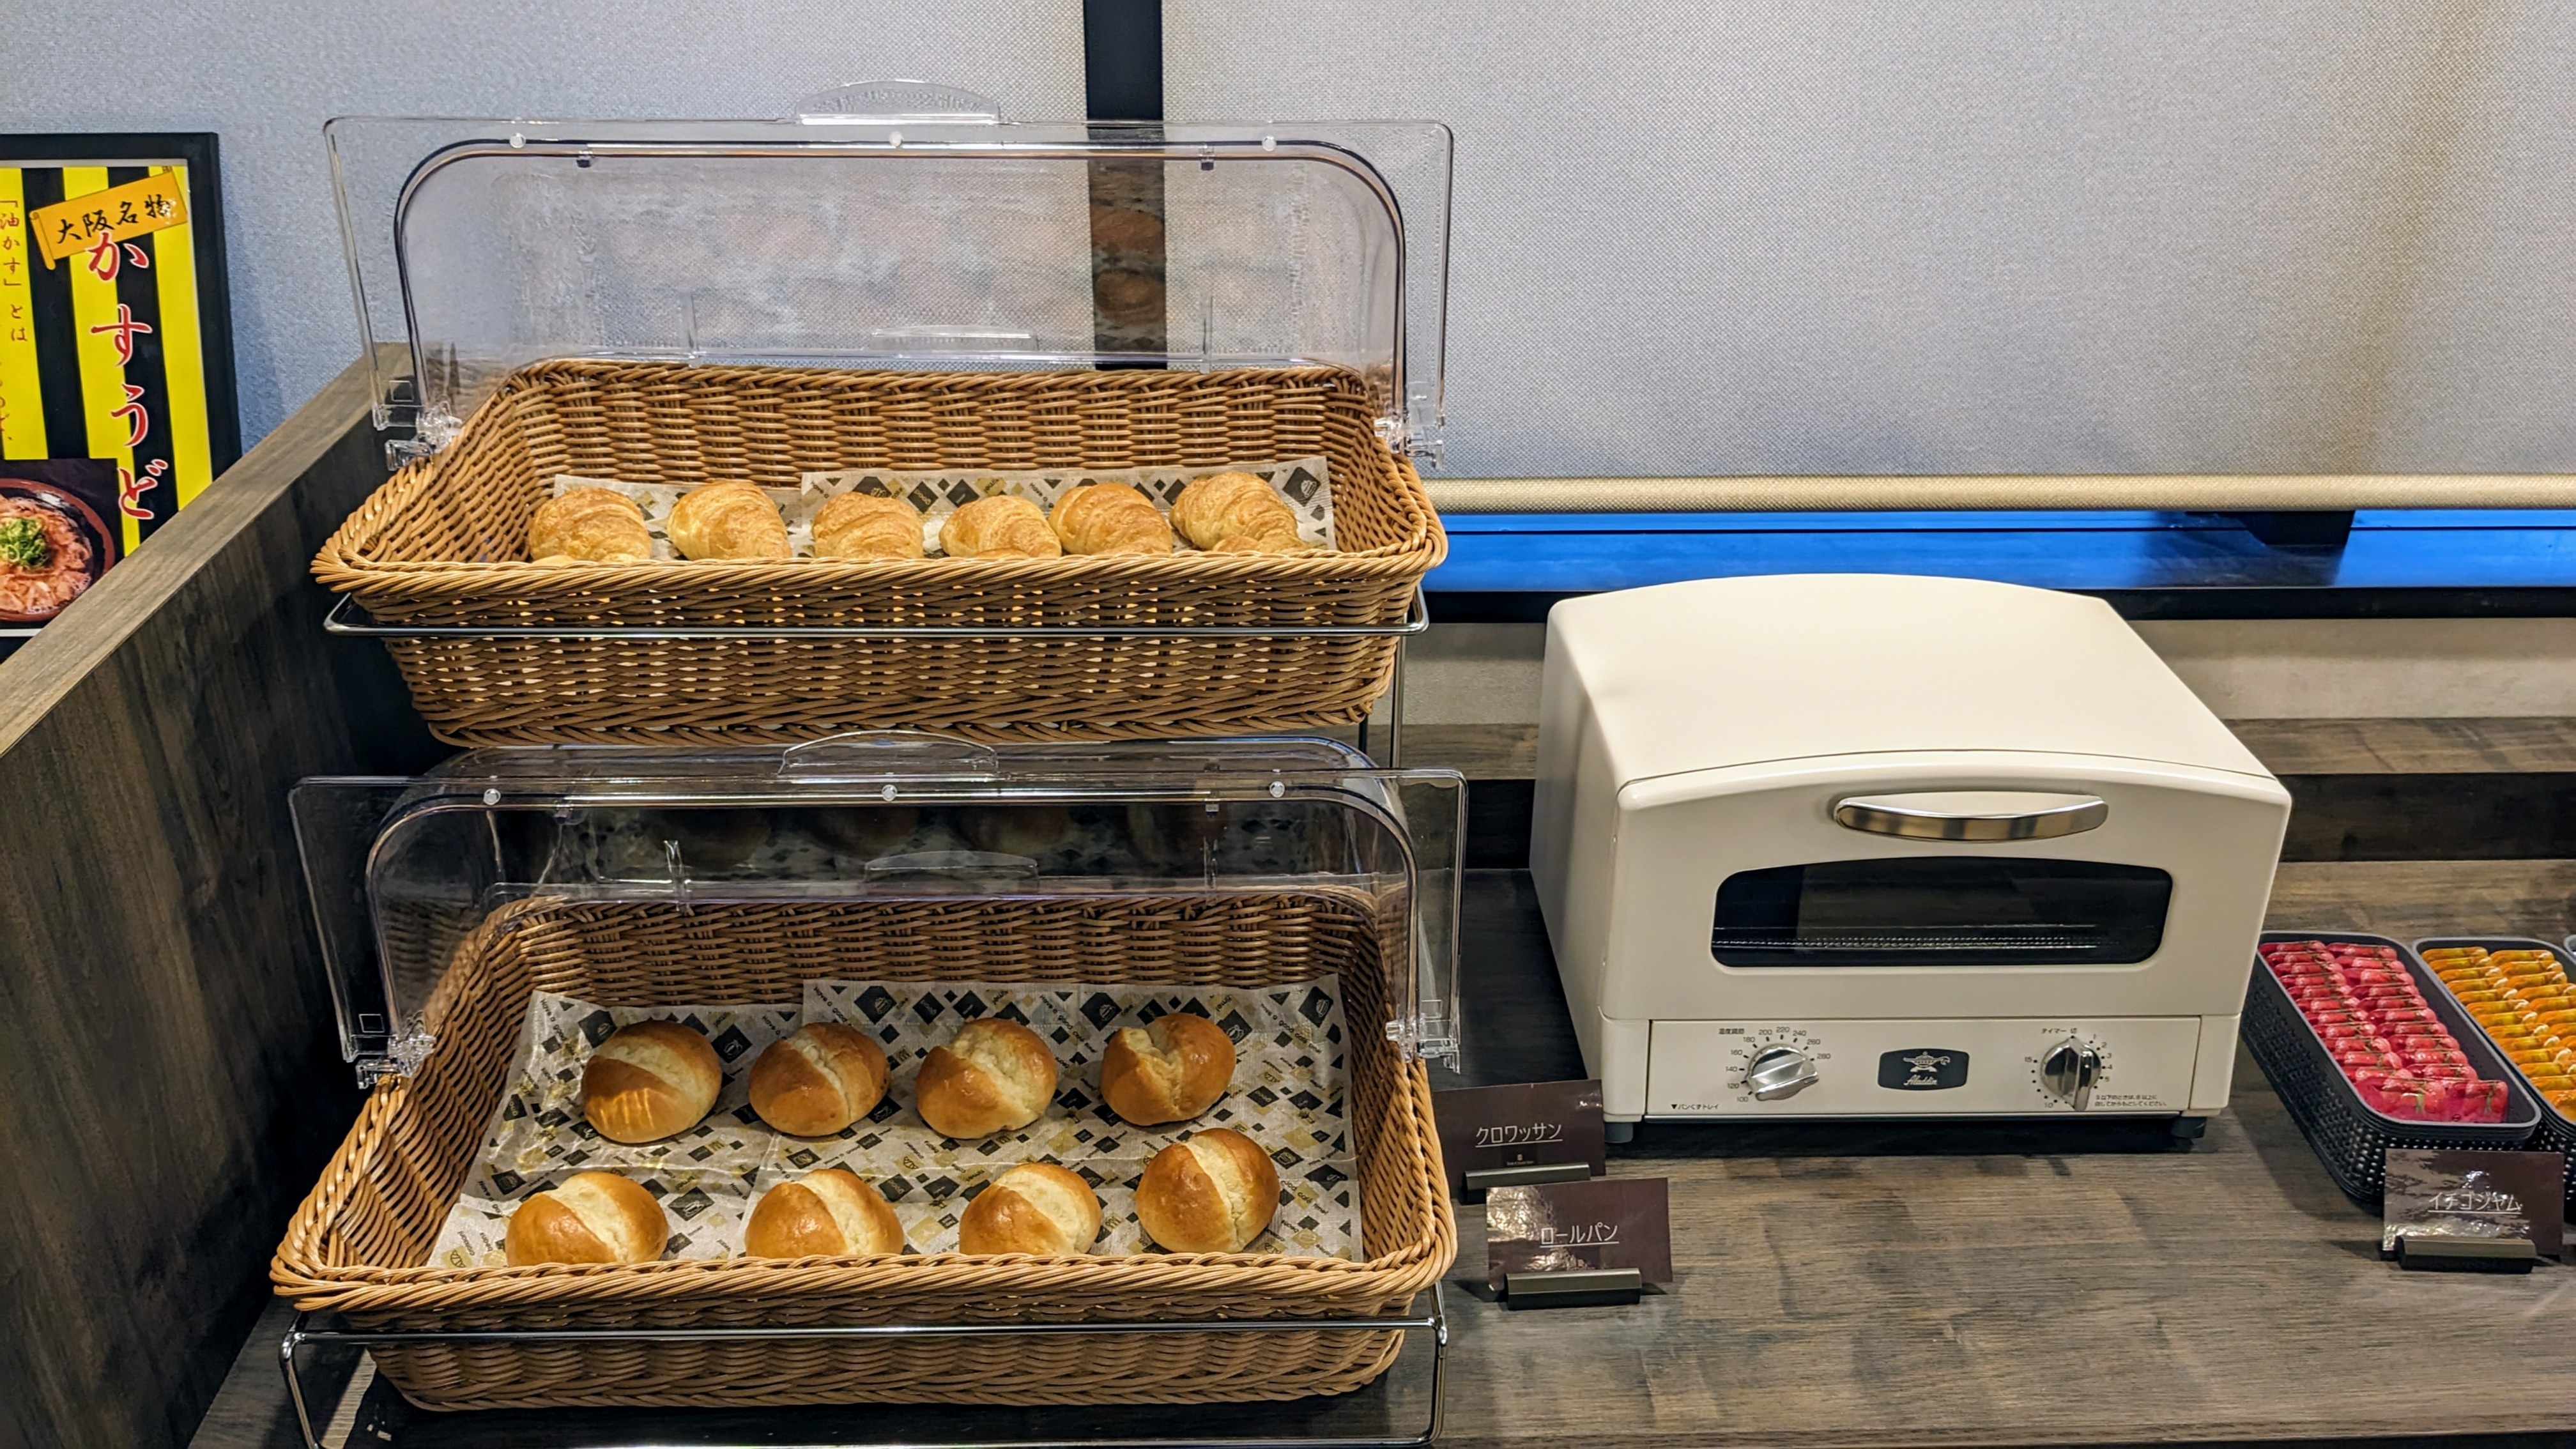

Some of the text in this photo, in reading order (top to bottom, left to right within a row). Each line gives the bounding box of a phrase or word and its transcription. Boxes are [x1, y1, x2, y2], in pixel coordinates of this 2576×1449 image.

[57, 194, 171, 244] 大阪名物
[1903, 1074, 1938, 1086] Aladdin
[1475, 1123, 1562, 1146] クロワッサン
[947, 1240, 960, 1250] goo
[1540, 1222, 1618, 1245] ロールパン
